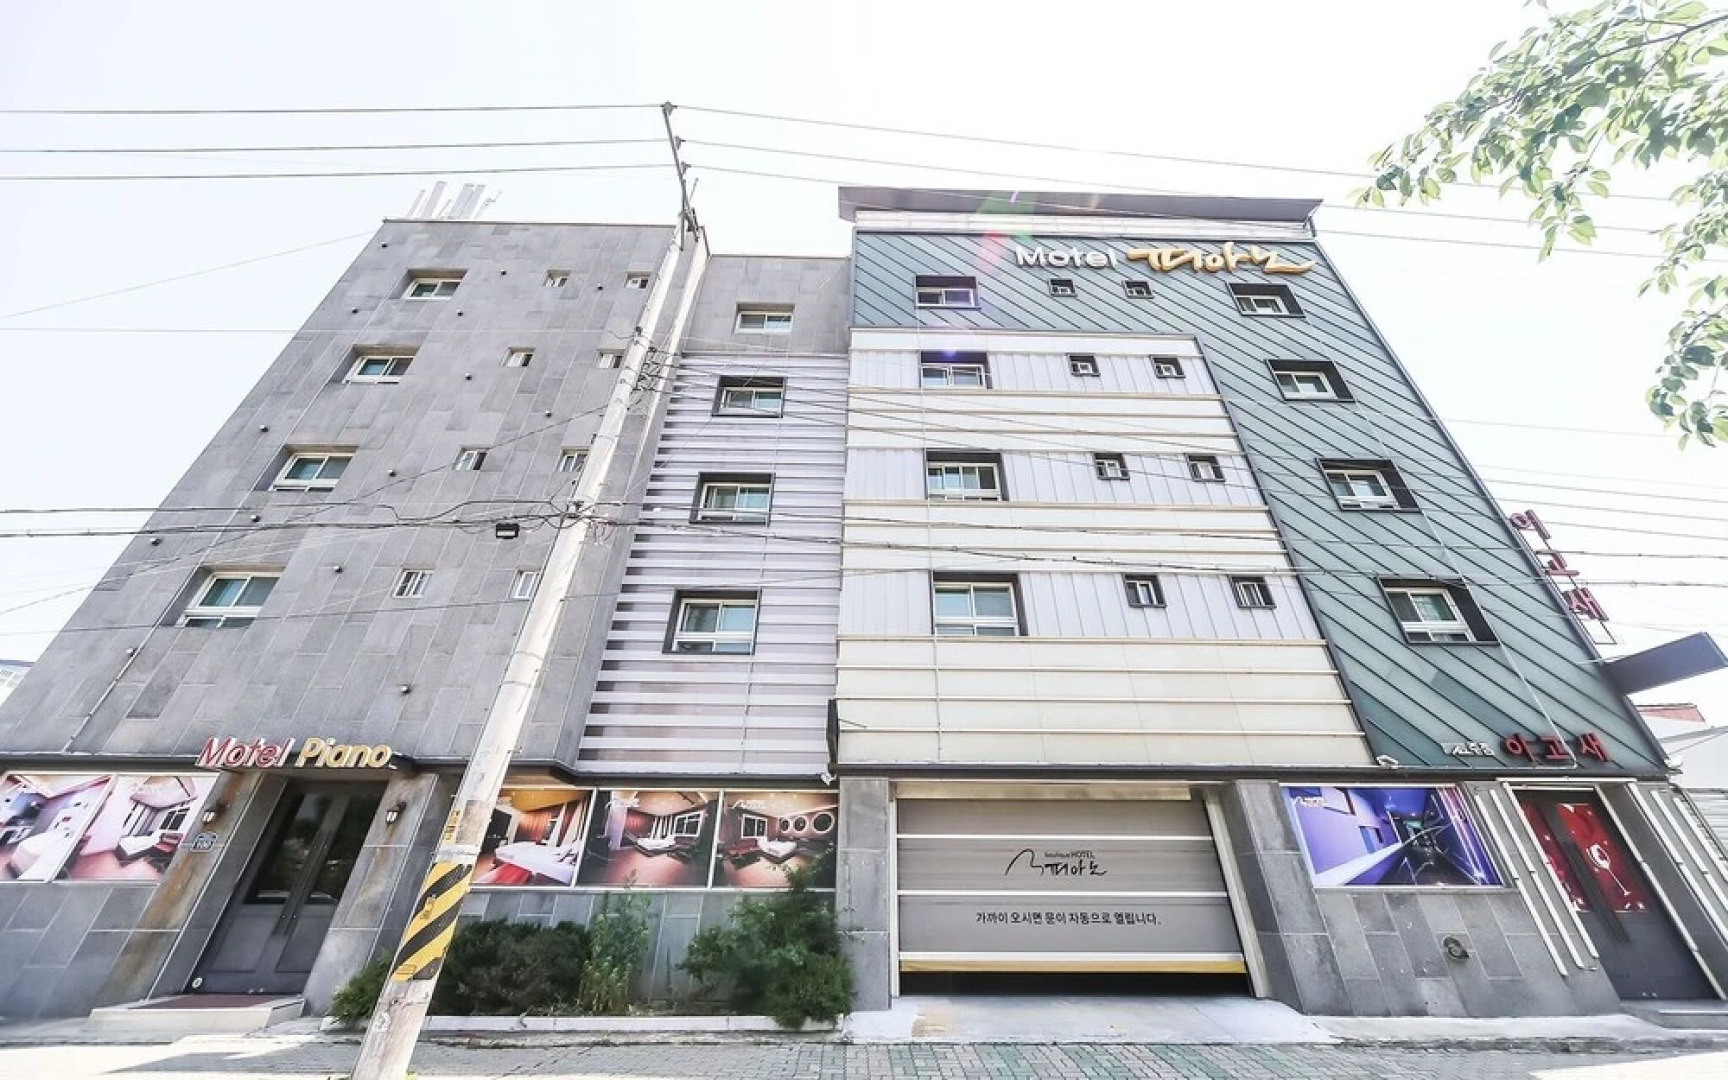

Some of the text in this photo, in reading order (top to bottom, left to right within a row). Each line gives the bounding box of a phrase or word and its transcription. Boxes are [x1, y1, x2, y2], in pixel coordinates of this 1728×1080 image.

[1015, 241, 1315, 274] Motel 피아노
[195, 737, 392, 768] Motel Piano
[1044, 859, 1108, 876] 피아노
[976, 911, 1162, 925] 가까이 오시면 문이 자동으로 열립니다.
